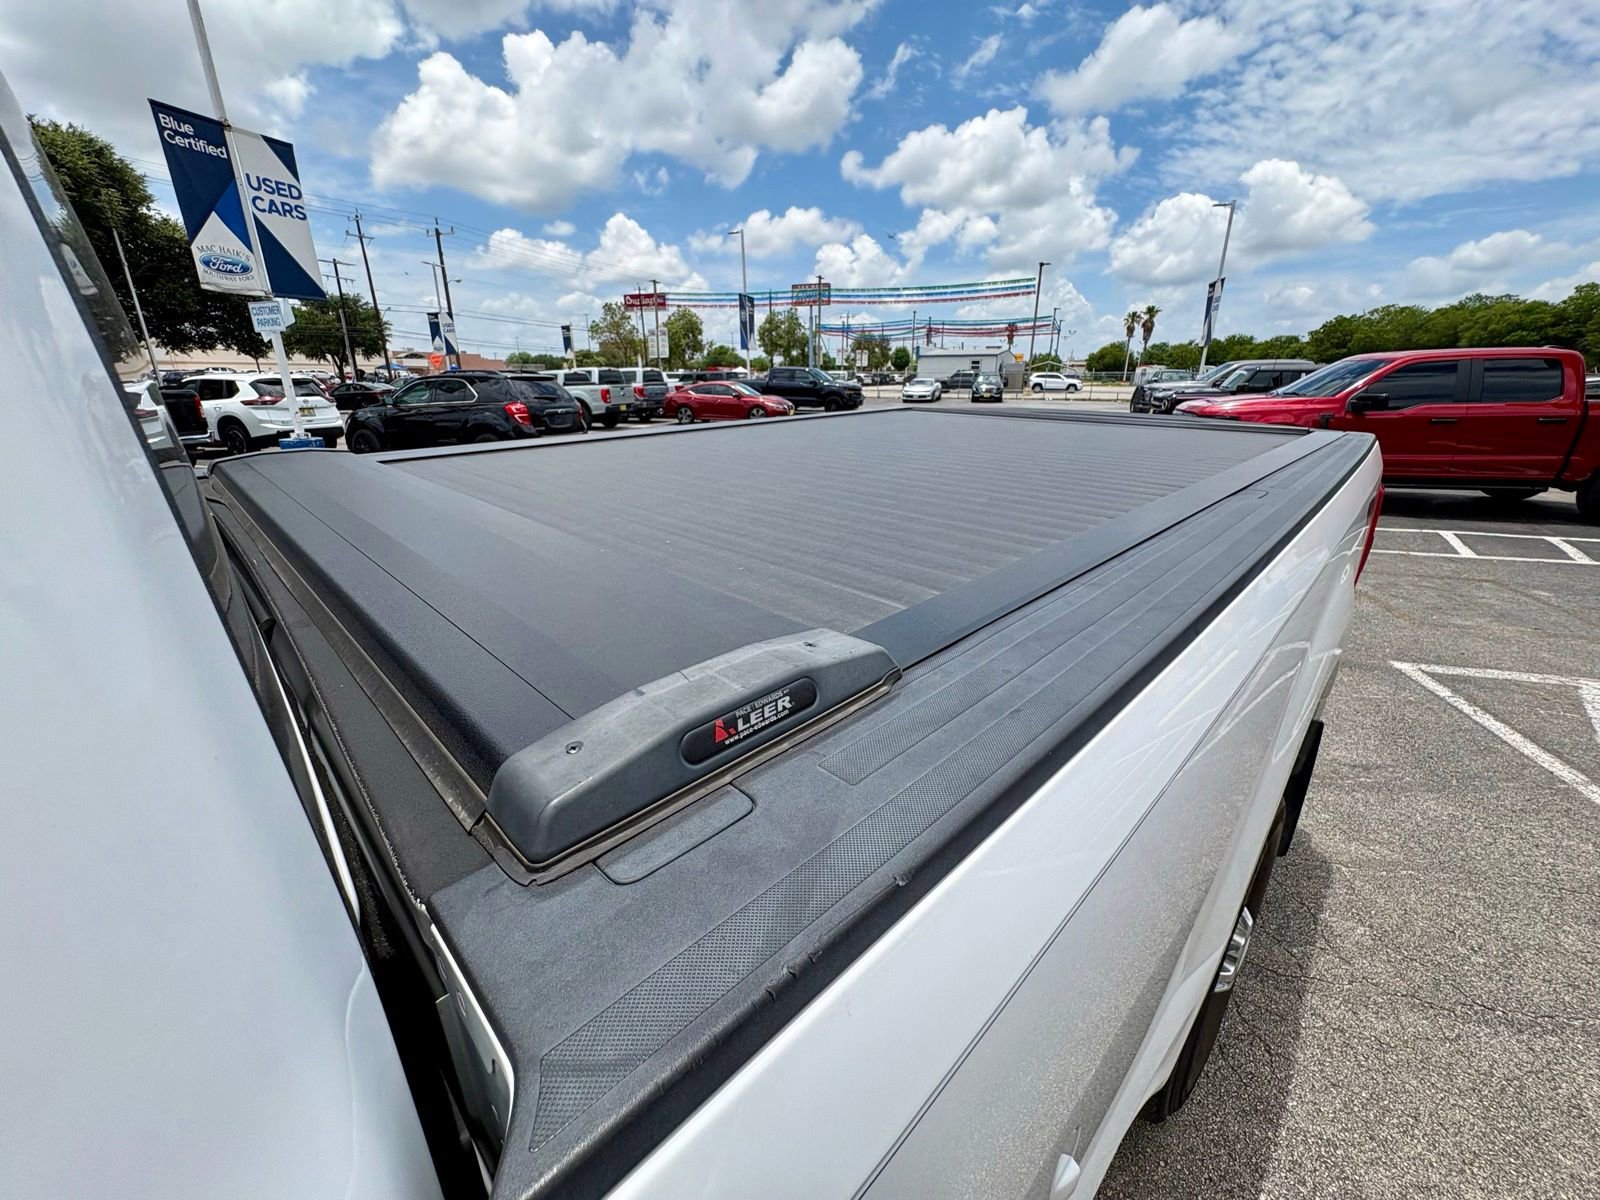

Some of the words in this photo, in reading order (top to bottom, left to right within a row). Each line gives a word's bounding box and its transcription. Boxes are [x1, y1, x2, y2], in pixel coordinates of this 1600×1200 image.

[158, 113, 194, 135] Blue
[163, 129, 228, 160] Certified
[245, 172, 303, 200] USED
[251, 195, 307, 221] CARS
[196, 244, 216, 253] MAC
[209, 255, 244, 273] Ford
[251, 305, 279, 317] CUSTOMER
[256, 317, 281, 328] PARKING
[735, 705, 752, 718] PACE
[754, 690, 783, 709] EDWARDS
[737, 695, 793, 732] LEER
[724, 709, 789, 745] www.pace-edwards.com
